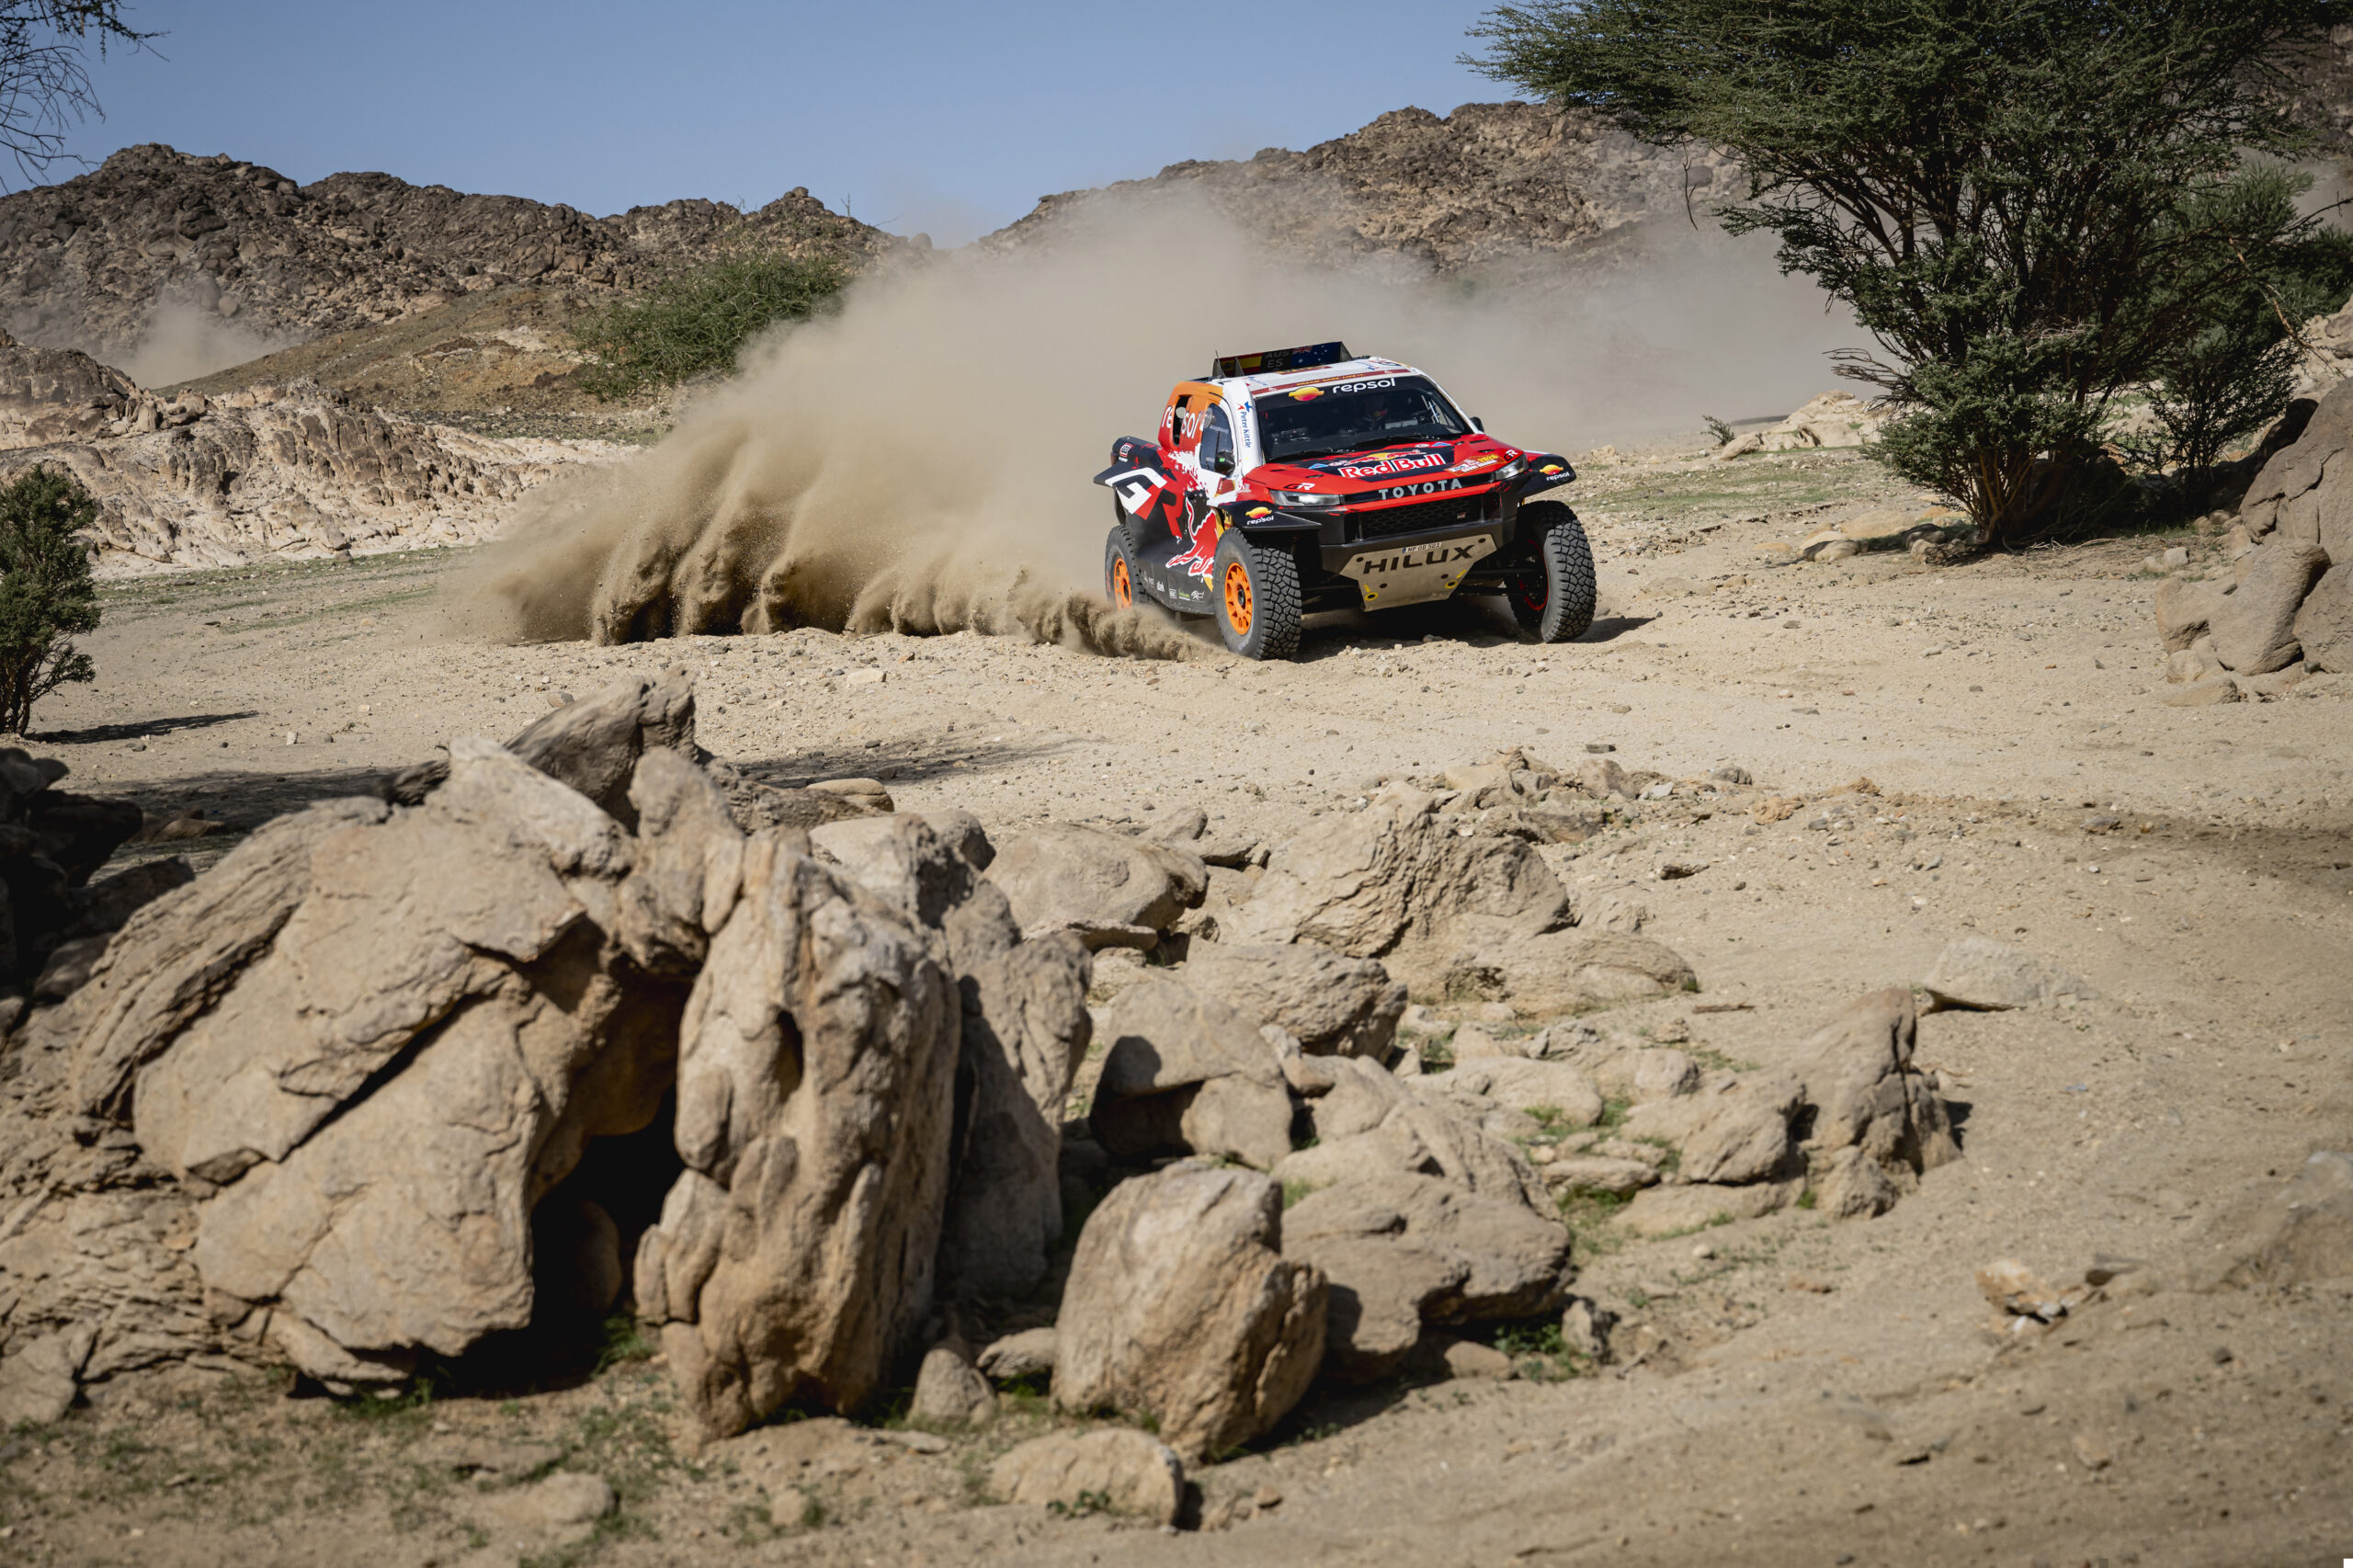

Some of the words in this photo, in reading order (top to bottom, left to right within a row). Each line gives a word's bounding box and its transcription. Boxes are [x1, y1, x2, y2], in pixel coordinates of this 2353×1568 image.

[1332, 377, 1396, 393] repsol
[1161, 406, 1201, 439] resol
[1337, 460, 1397, 478] Red
[1391, 453, 1447, 472] Bull
[1546, 472, 1570, 481] repsol
[1283, 483, 1315, 491] GR
[1379, 478, 1463, 500] TOYOTA
[1247, 516, 1274, 525] repsol
[1363, 544, 1475, 574] HILUX
